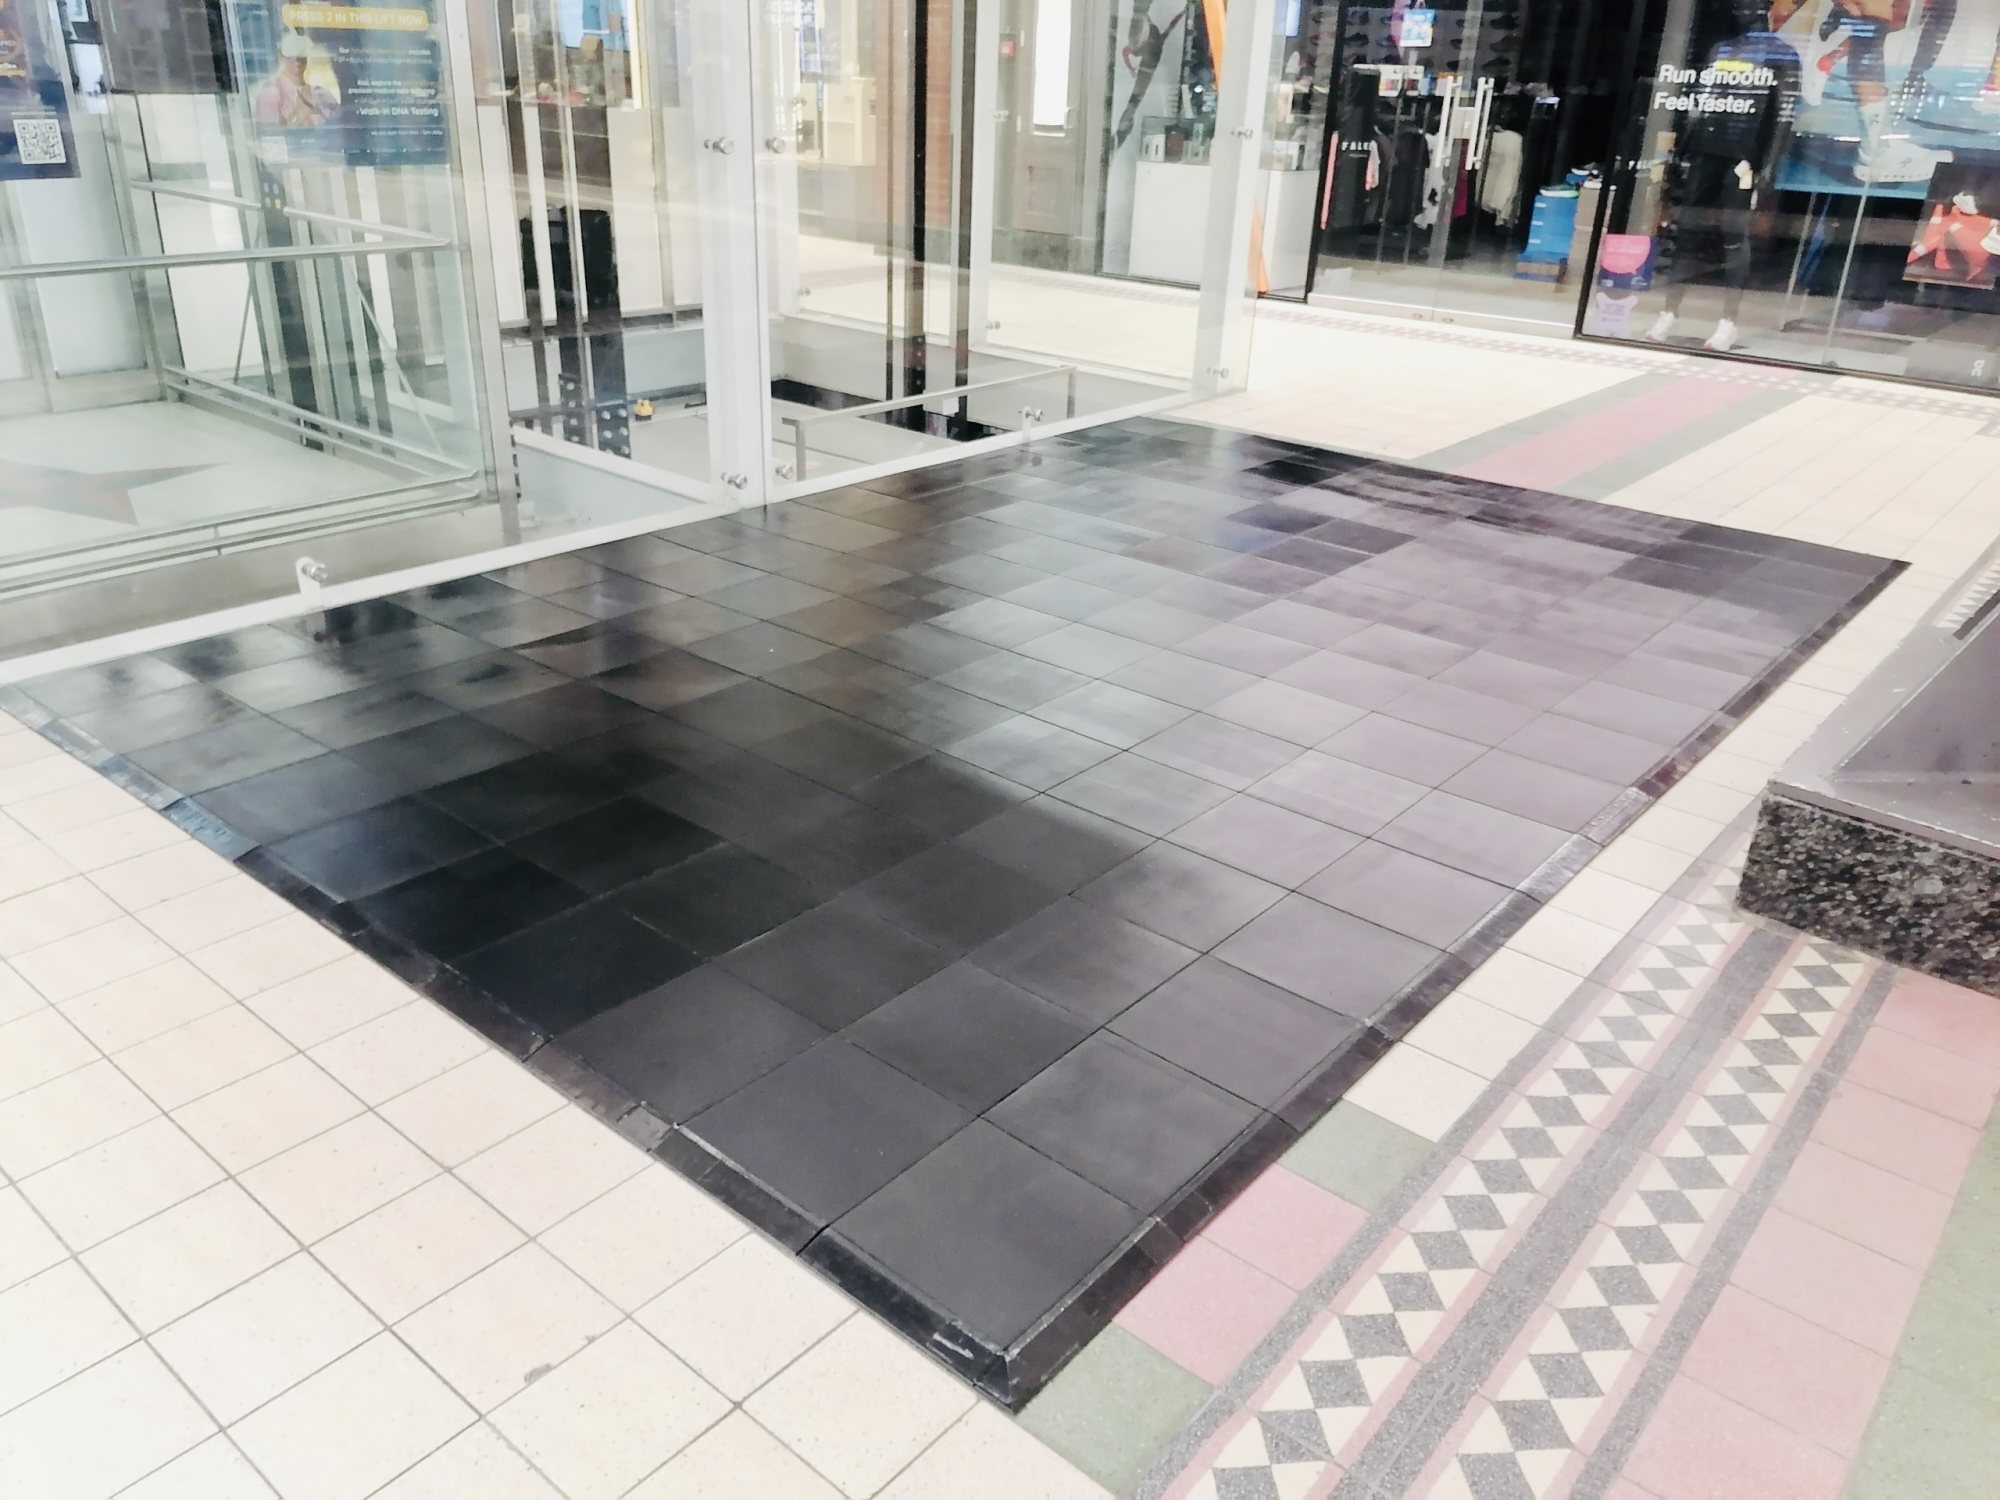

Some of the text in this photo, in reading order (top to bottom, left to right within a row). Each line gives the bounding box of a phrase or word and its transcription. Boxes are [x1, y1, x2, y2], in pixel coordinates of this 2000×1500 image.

[288, 10, 323, 22] PRESS
[335, 12, 346, 23] IN
[350, 12, 373, 24] THIS
[375, 13, 395, 24] LIFT
[398, 14, 422, 25] NOW
[1659, 64, 1778, 87] Run smooth.
[391, 106, 409, 116] DNA
[410, 106, 439, 117] Testing
[1653, 92, 1756, 113] Feel faster.
